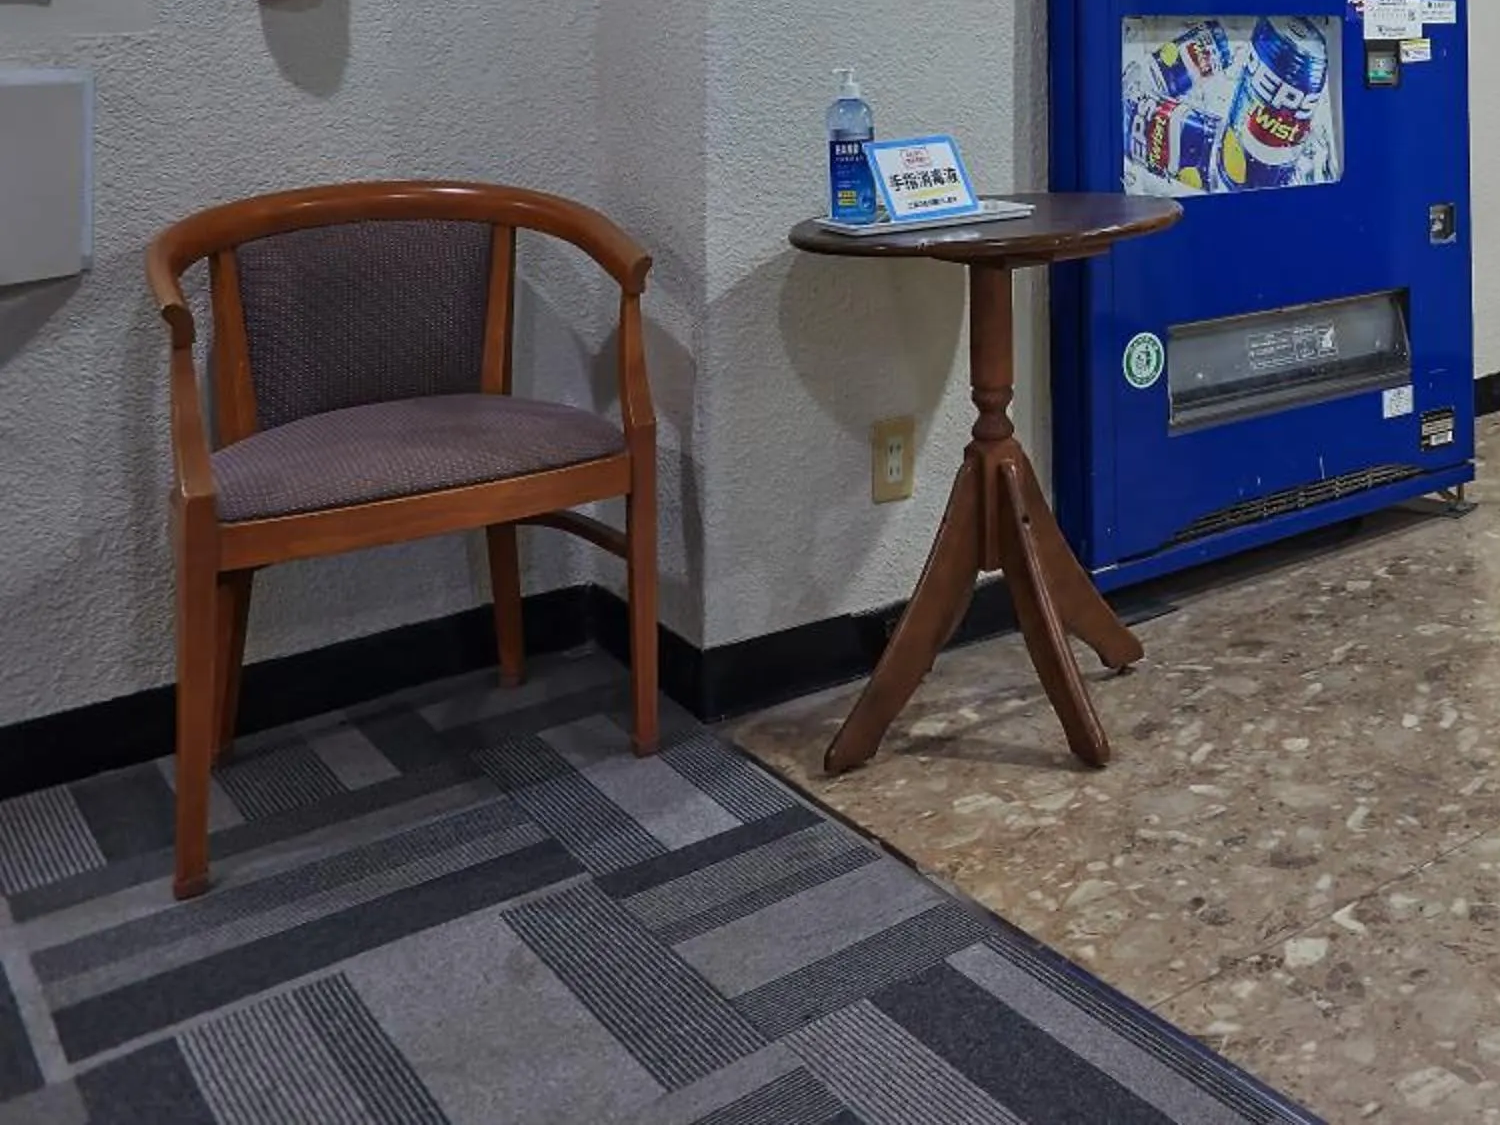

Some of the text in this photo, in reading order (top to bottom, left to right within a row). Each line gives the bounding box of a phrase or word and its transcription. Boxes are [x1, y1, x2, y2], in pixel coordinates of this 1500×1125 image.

[892, 166, 960, 192] 手指消毒液
